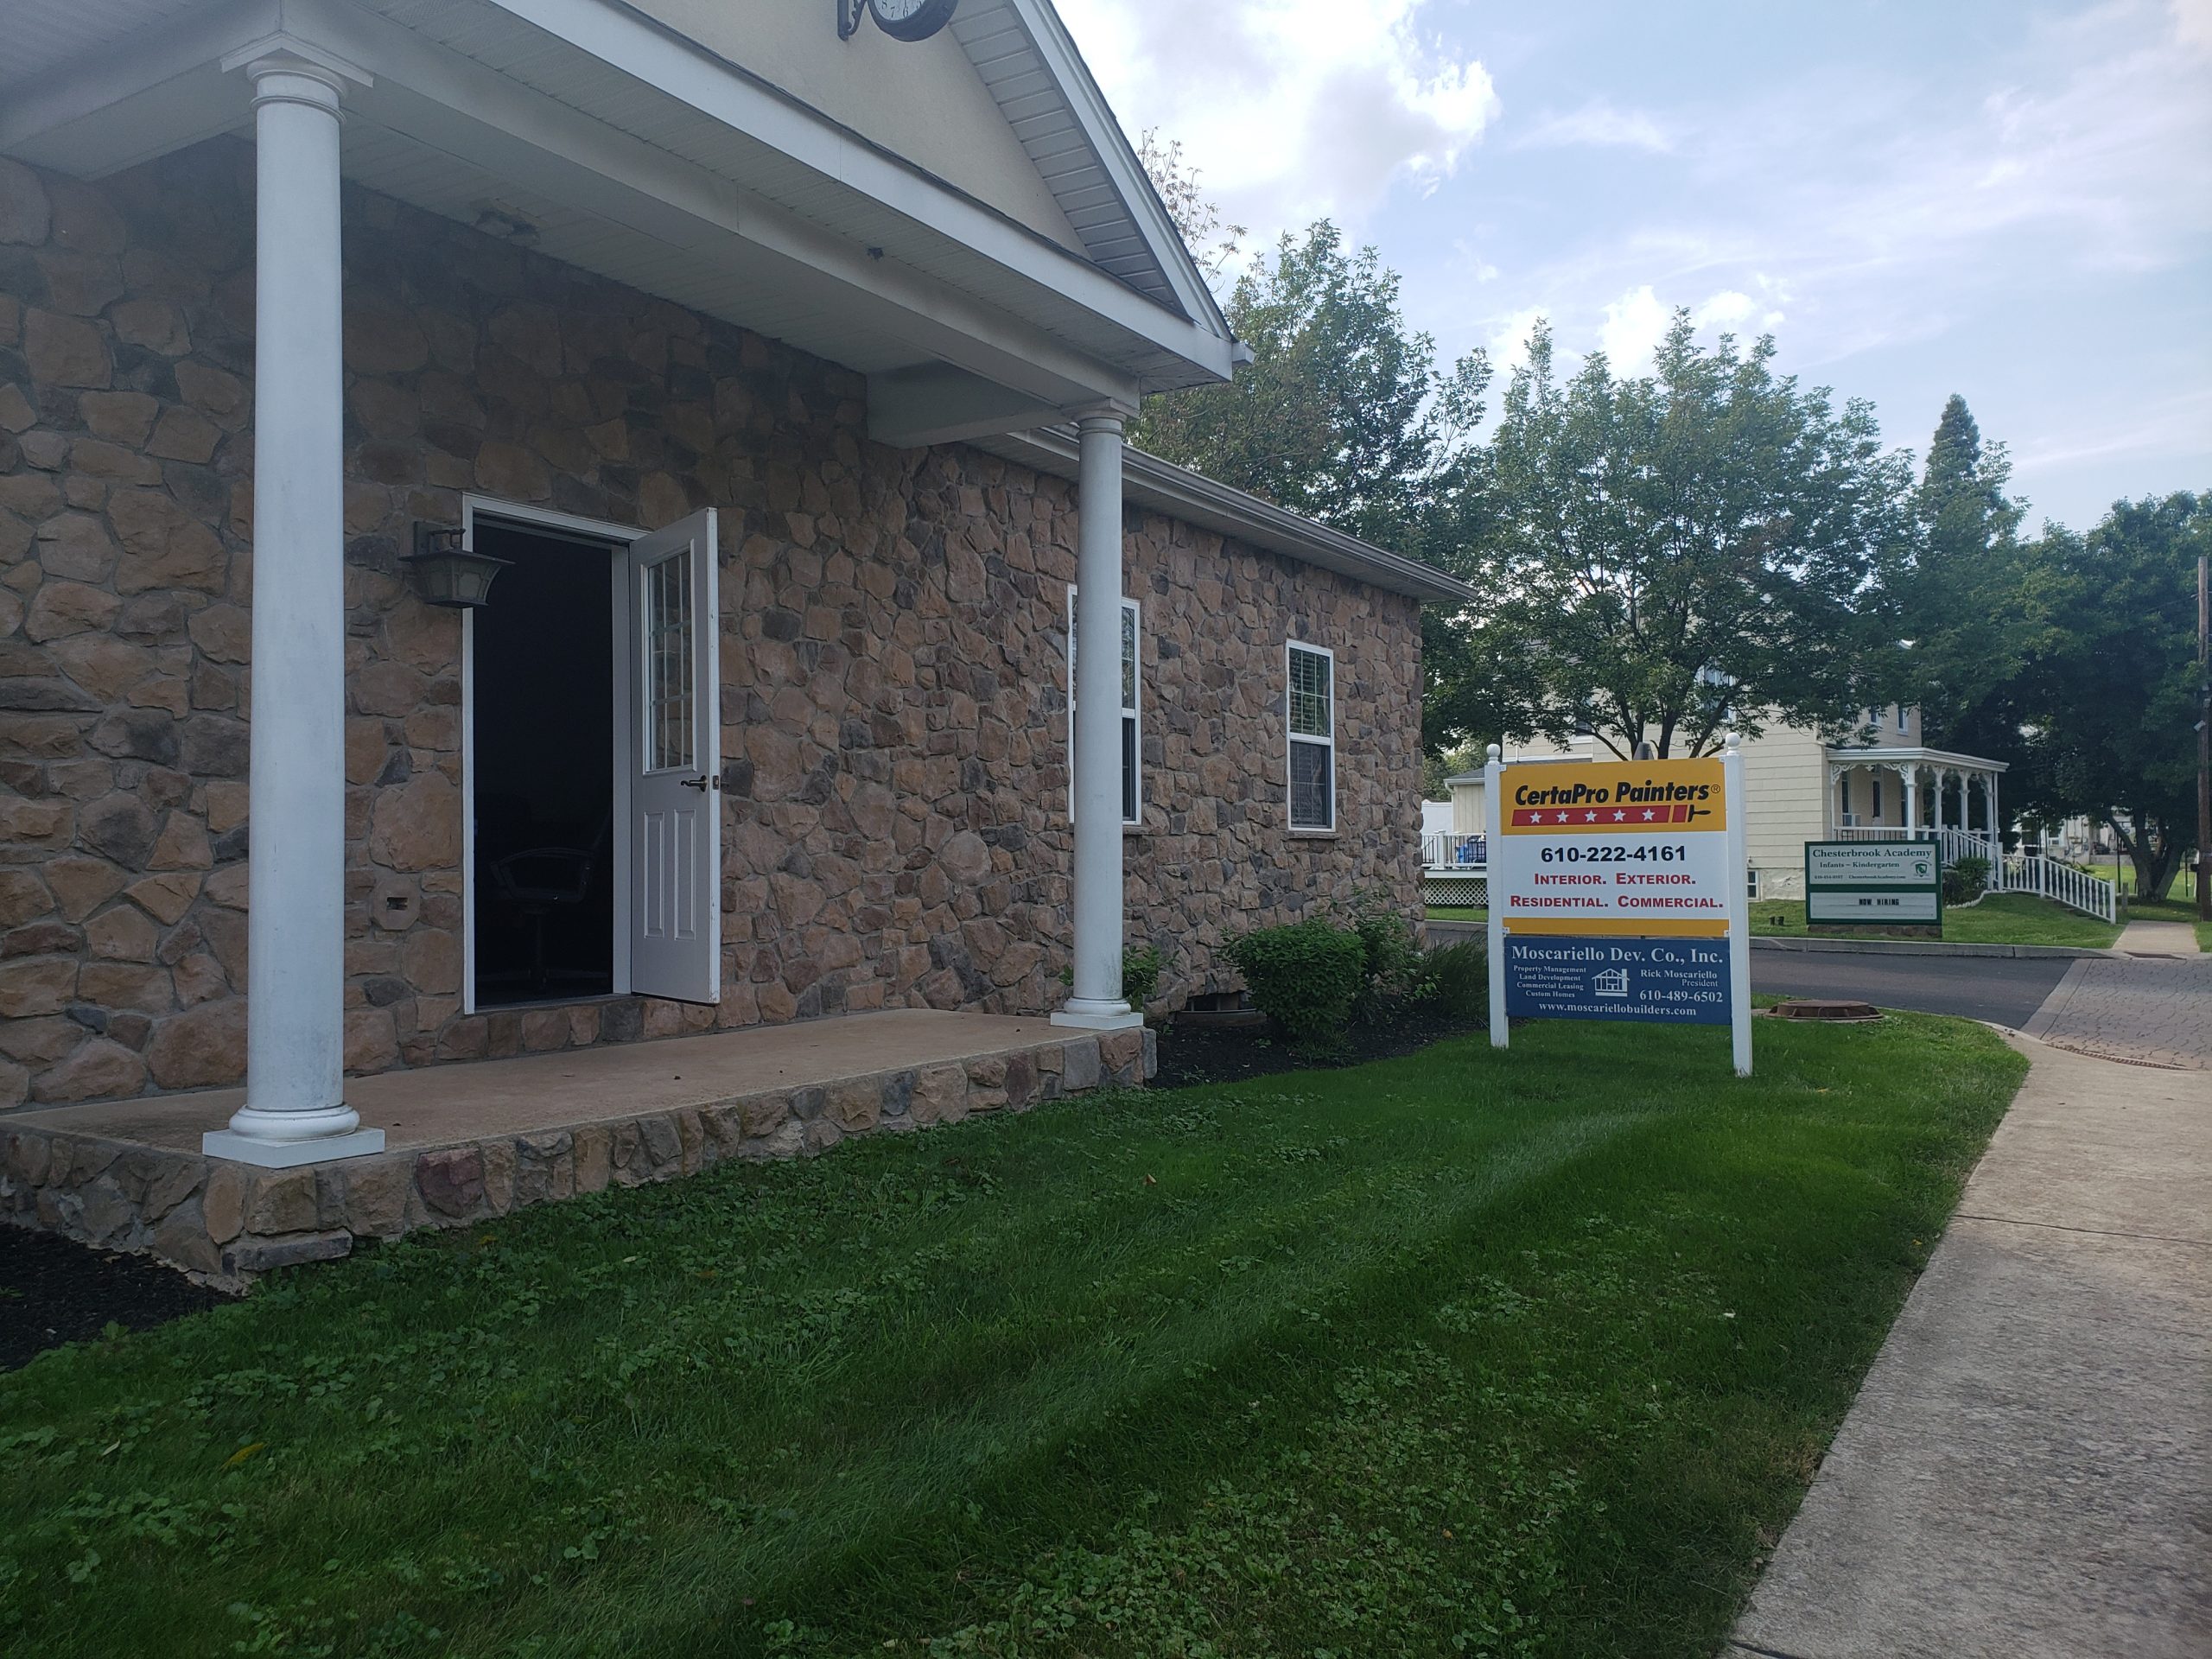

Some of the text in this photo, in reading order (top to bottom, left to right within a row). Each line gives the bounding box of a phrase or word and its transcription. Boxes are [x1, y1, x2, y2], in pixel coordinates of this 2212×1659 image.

[1516, 784, 1609, 805] CertaPro
[1541, 845, 1686, 862] 610-222-4161
[1813, 849, 1932, 859] Chesterbrook Academy
[1512, 945, 1724, 965] Moscariello Dev. Co., Inc.
[1640, 969, 1718, 979] Rick Moscariello
[1639, 989, 1724, 1002] 610-489-6502
[1539, 1002, 1697, 1016] www.moscariellobuilders.com
